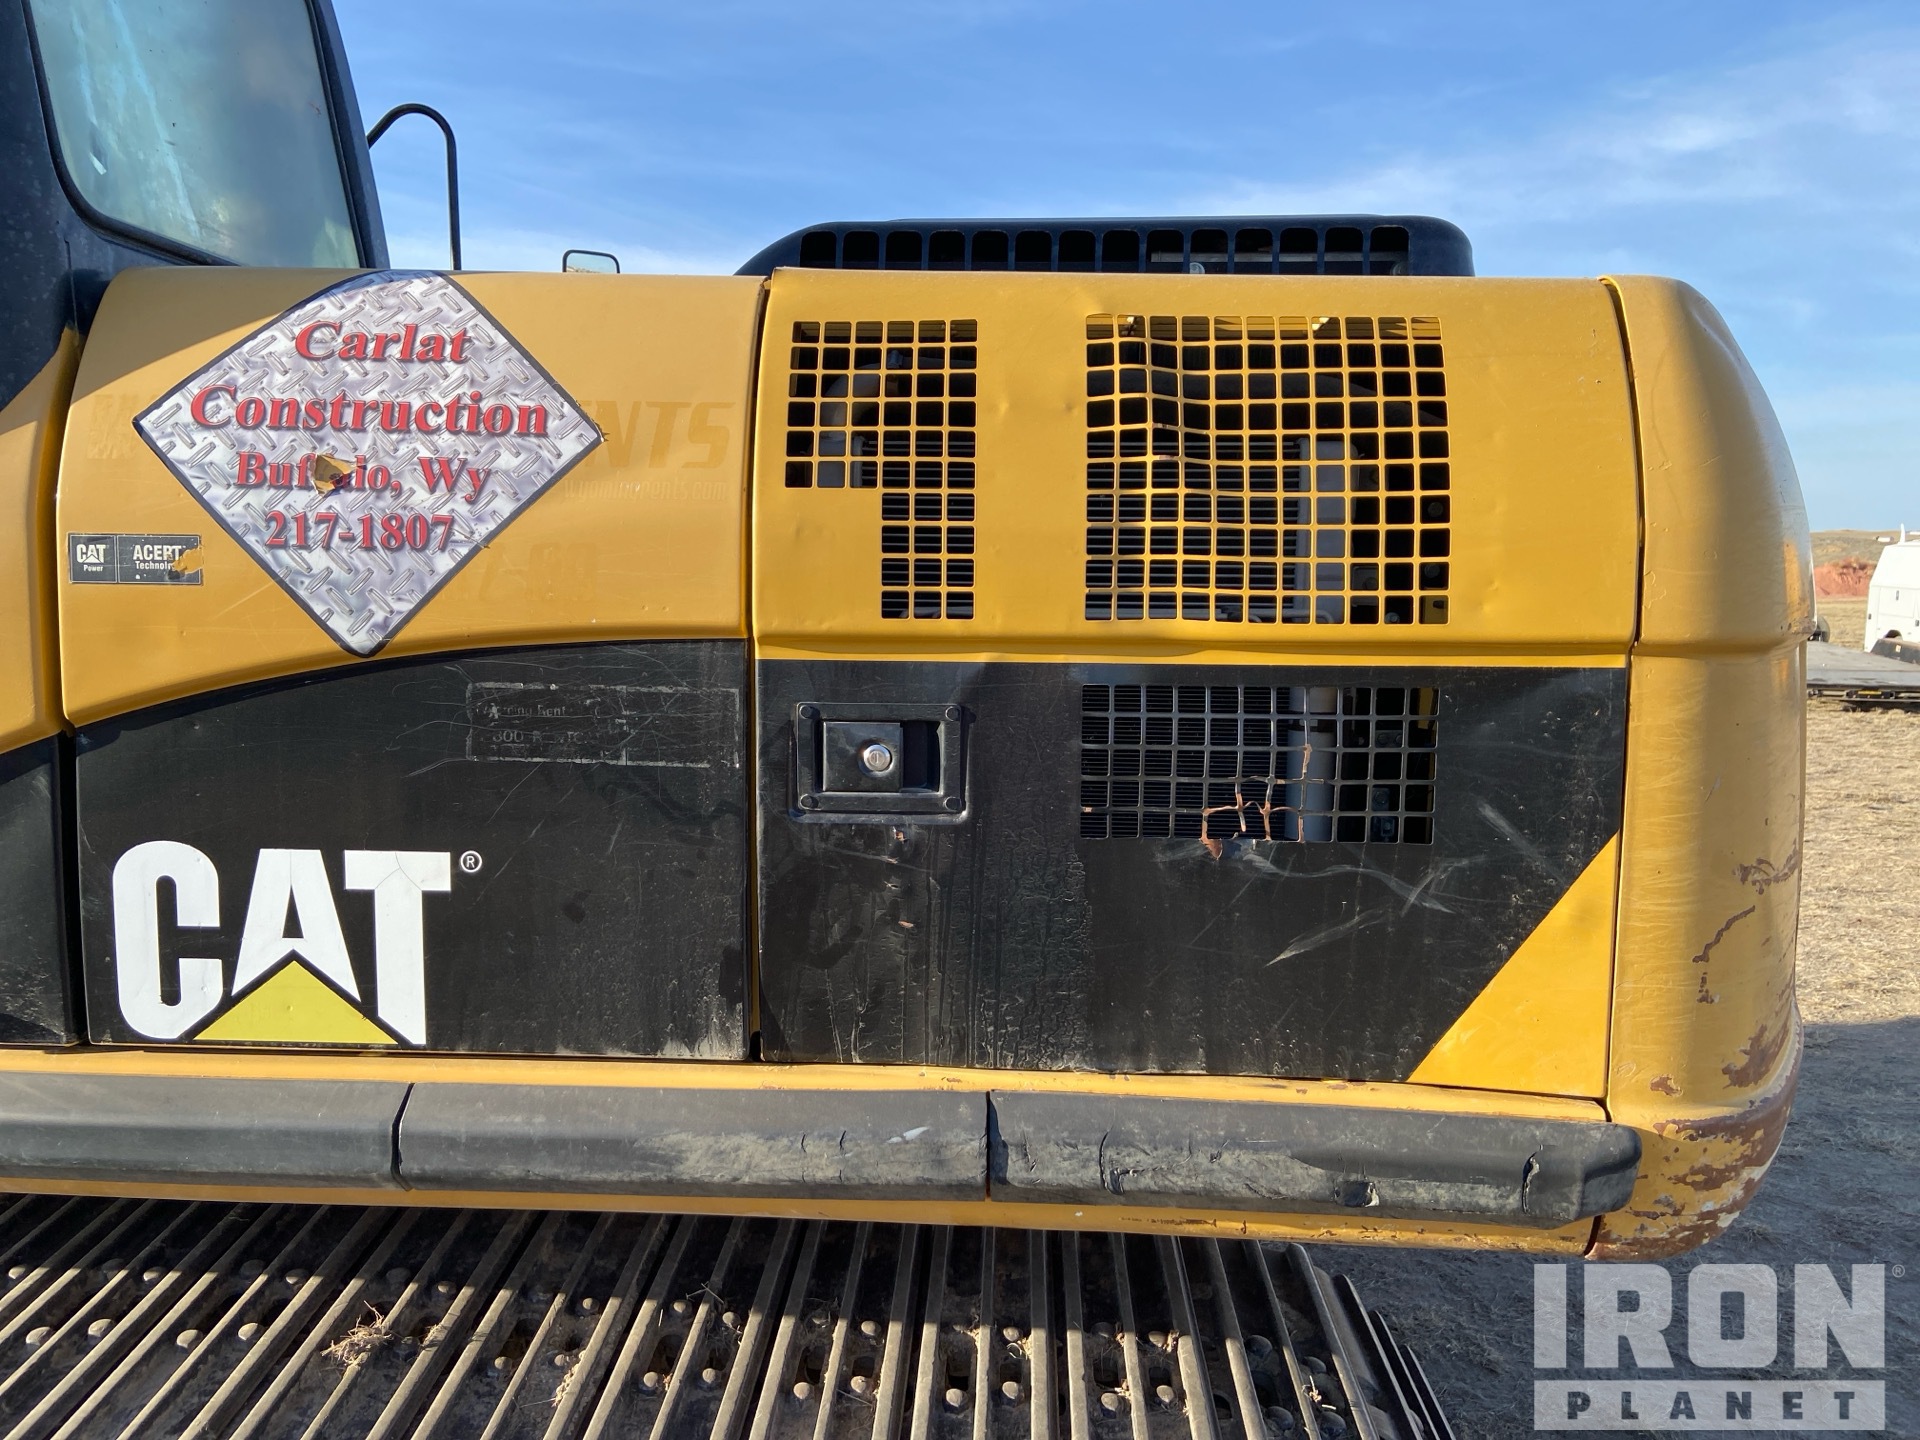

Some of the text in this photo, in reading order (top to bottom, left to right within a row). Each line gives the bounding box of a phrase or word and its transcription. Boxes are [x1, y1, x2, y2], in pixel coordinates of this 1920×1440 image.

[295, 321, 471, 363] Carlat
[190, 384, 550, 437] Construction
[236, 451, 491, 503] Buflo, Wy
[265, 510, 454, 550] 217-1807
[76, 543, 182, 563] CAT ACERT
[83, 564, 104, 572] Power
[112, 840, 452, 1045] CAT
